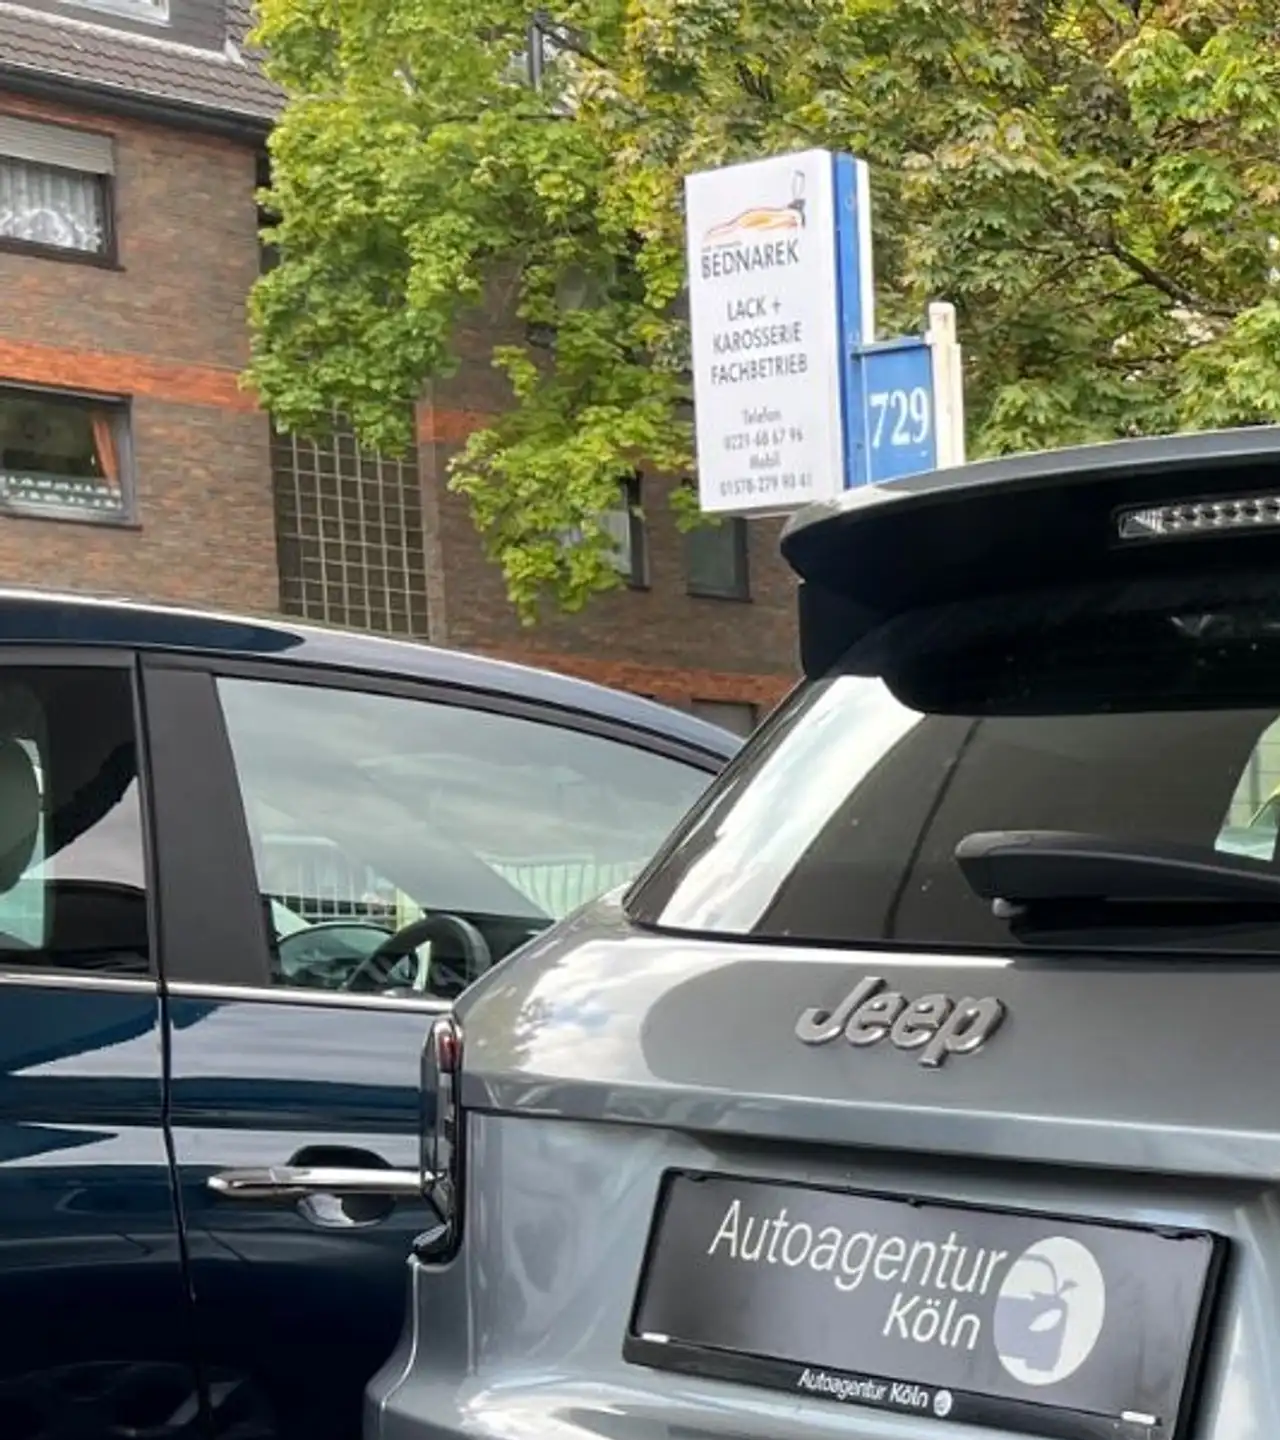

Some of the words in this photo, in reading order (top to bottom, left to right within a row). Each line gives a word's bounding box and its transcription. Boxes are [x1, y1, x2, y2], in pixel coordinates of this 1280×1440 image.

[701, 239, 799, 279] BEDNAREK
[727, 296, 766, 321] LACK
[713, 321, 802, 354] KAROSSERIE
[710, 352, 808, 385] FACHBETRIEB
[869, 386, 929, 449] 729
[795, 976, 1007, 1068] Jeep
[708, 1198, 1009, 1297] Autoagentur
[882, 1293, 981, 1351] Köln
[797, 1367, 888, 1400] Autoagentur
[889, 1381, 929, 1408] Köln
